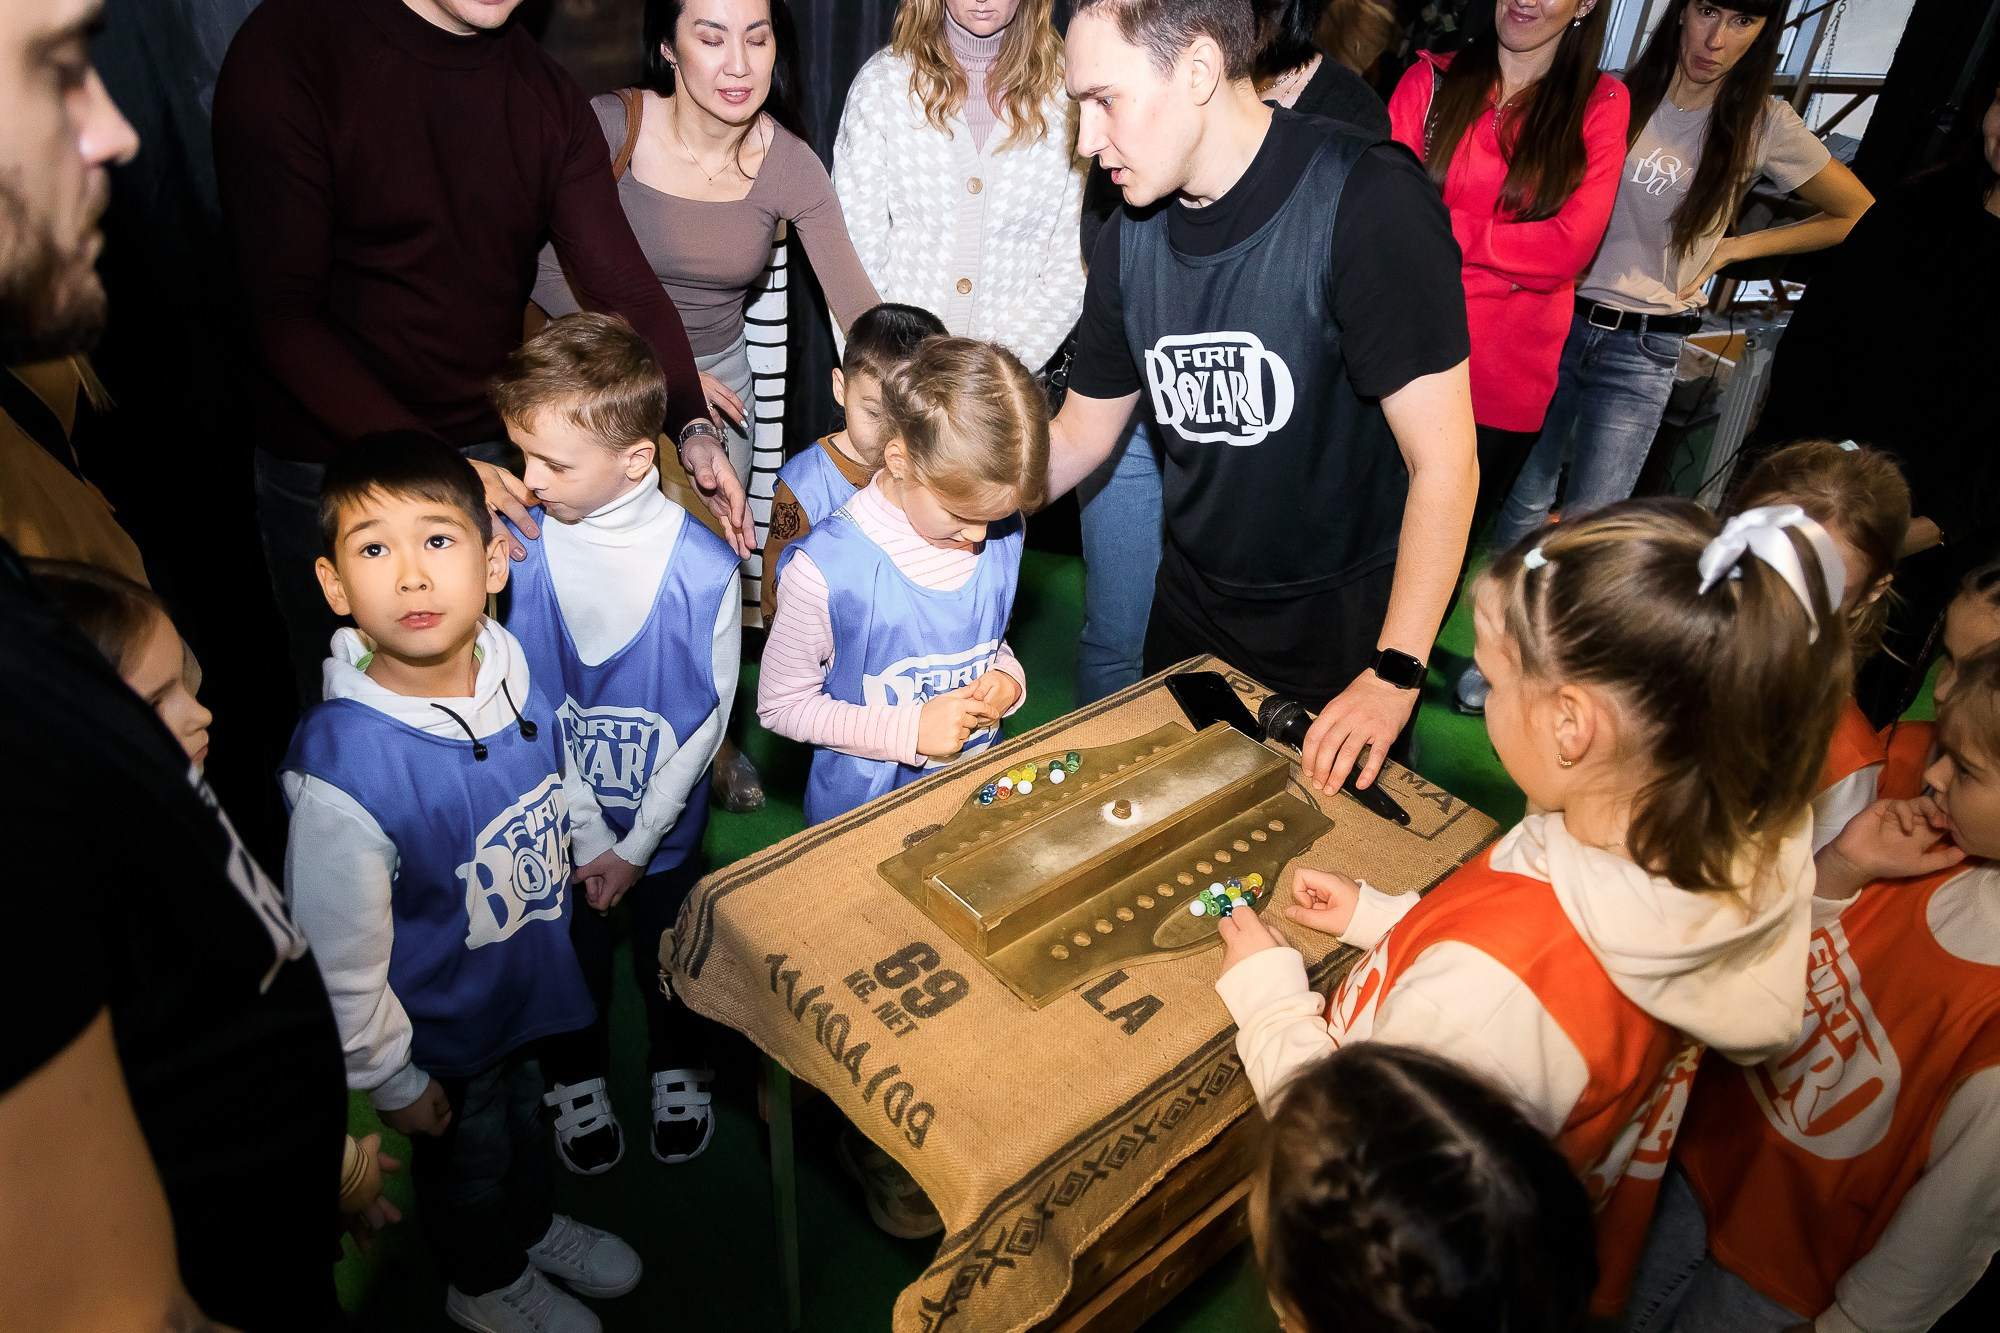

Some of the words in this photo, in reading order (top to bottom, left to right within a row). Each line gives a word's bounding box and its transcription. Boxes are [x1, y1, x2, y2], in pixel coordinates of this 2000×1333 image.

[1174, 347, 1237, 369] FORT
[1145, 347, 1295, 434] BOYARD
[569, 710, 638, 740] ORT
[873, 941, 970, 1019] 69
[871, 1000, 920, 1038] NET
